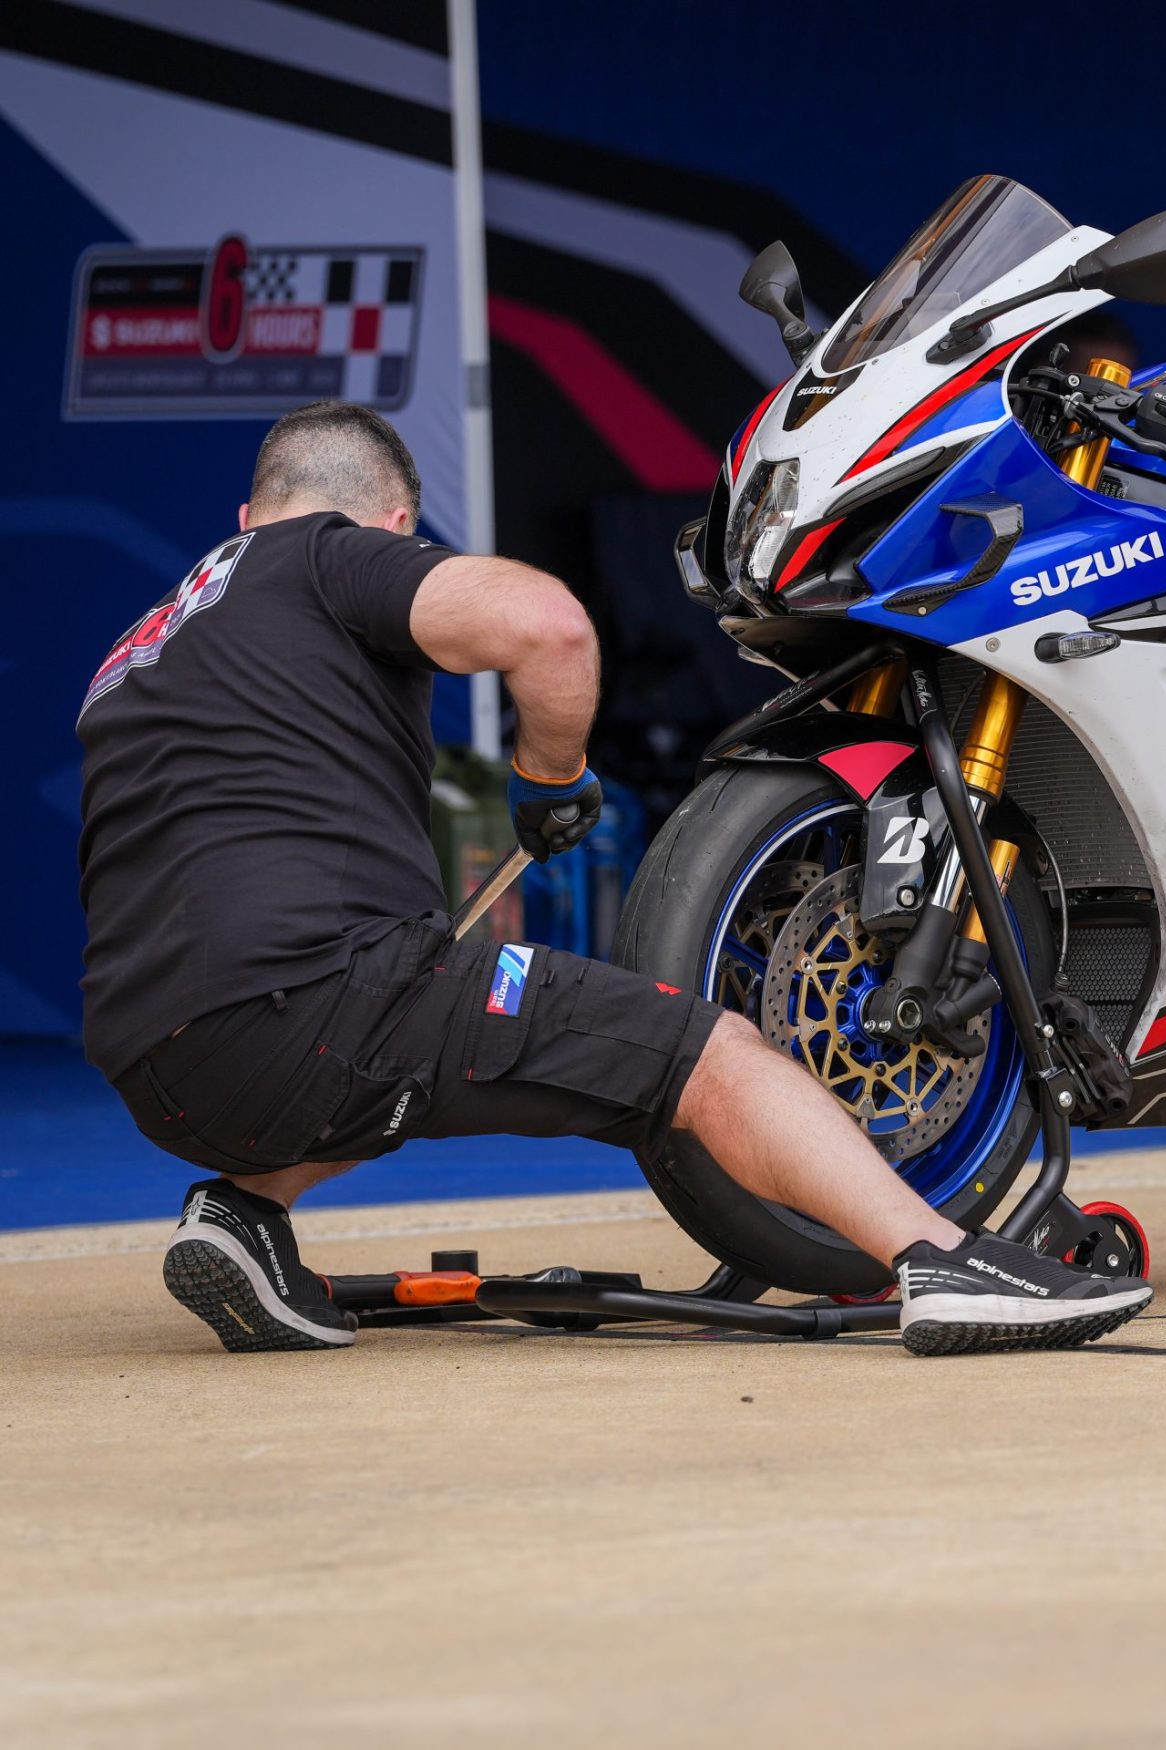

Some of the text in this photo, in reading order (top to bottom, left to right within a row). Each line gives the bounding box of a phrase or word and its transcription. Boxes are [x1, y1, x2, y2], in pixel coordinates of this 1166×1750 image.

[206, 235, 248, 352] 6
[796, 386, 837, 396] SUZUKI
[1010, 530, 1165, 606] SUZUKI
[496, 970, 512, 1009] SUZUKI
[389, 1091, 412, 1129] SUZUKI
[256, 1223, 290, 1296] alpinestars
[966, 1257, 1050, 1297] alpinestars
